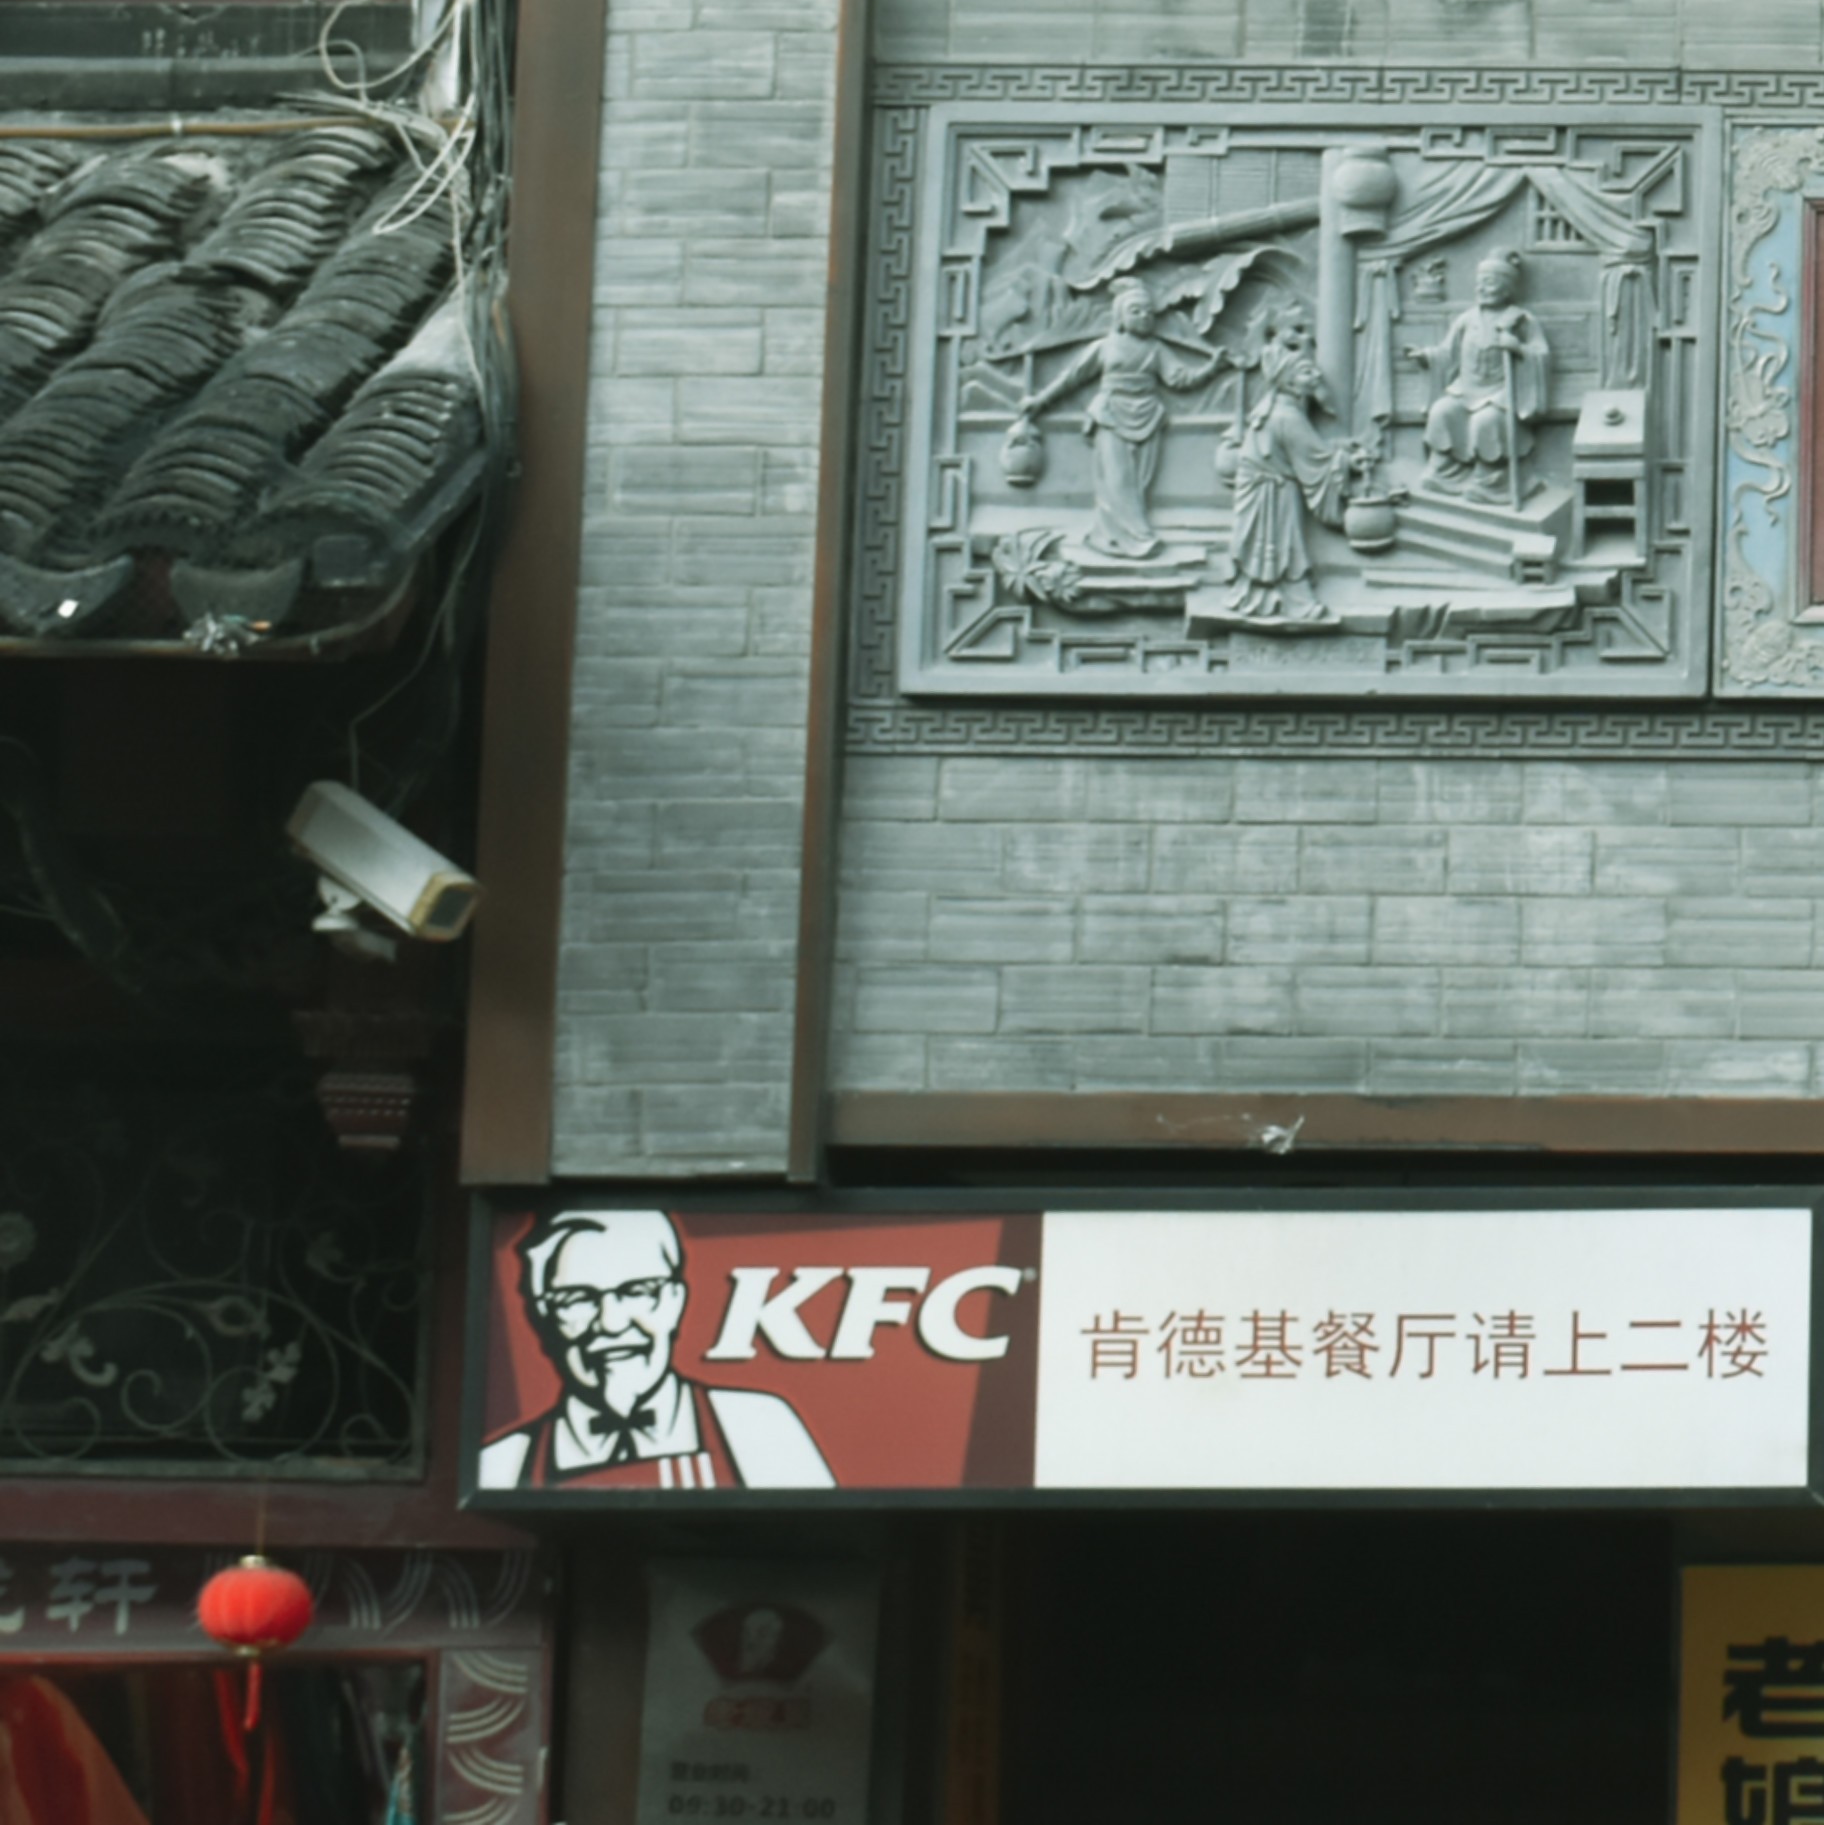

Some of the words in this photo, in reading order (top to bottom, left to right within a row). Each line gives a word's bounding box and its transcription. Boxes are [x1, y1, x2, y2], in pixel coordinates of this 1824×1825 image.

[707, 1265, 1022, 1362] KFC
[1080, 1307, 1771, 1382] 肯德基餐厅请上二楼
